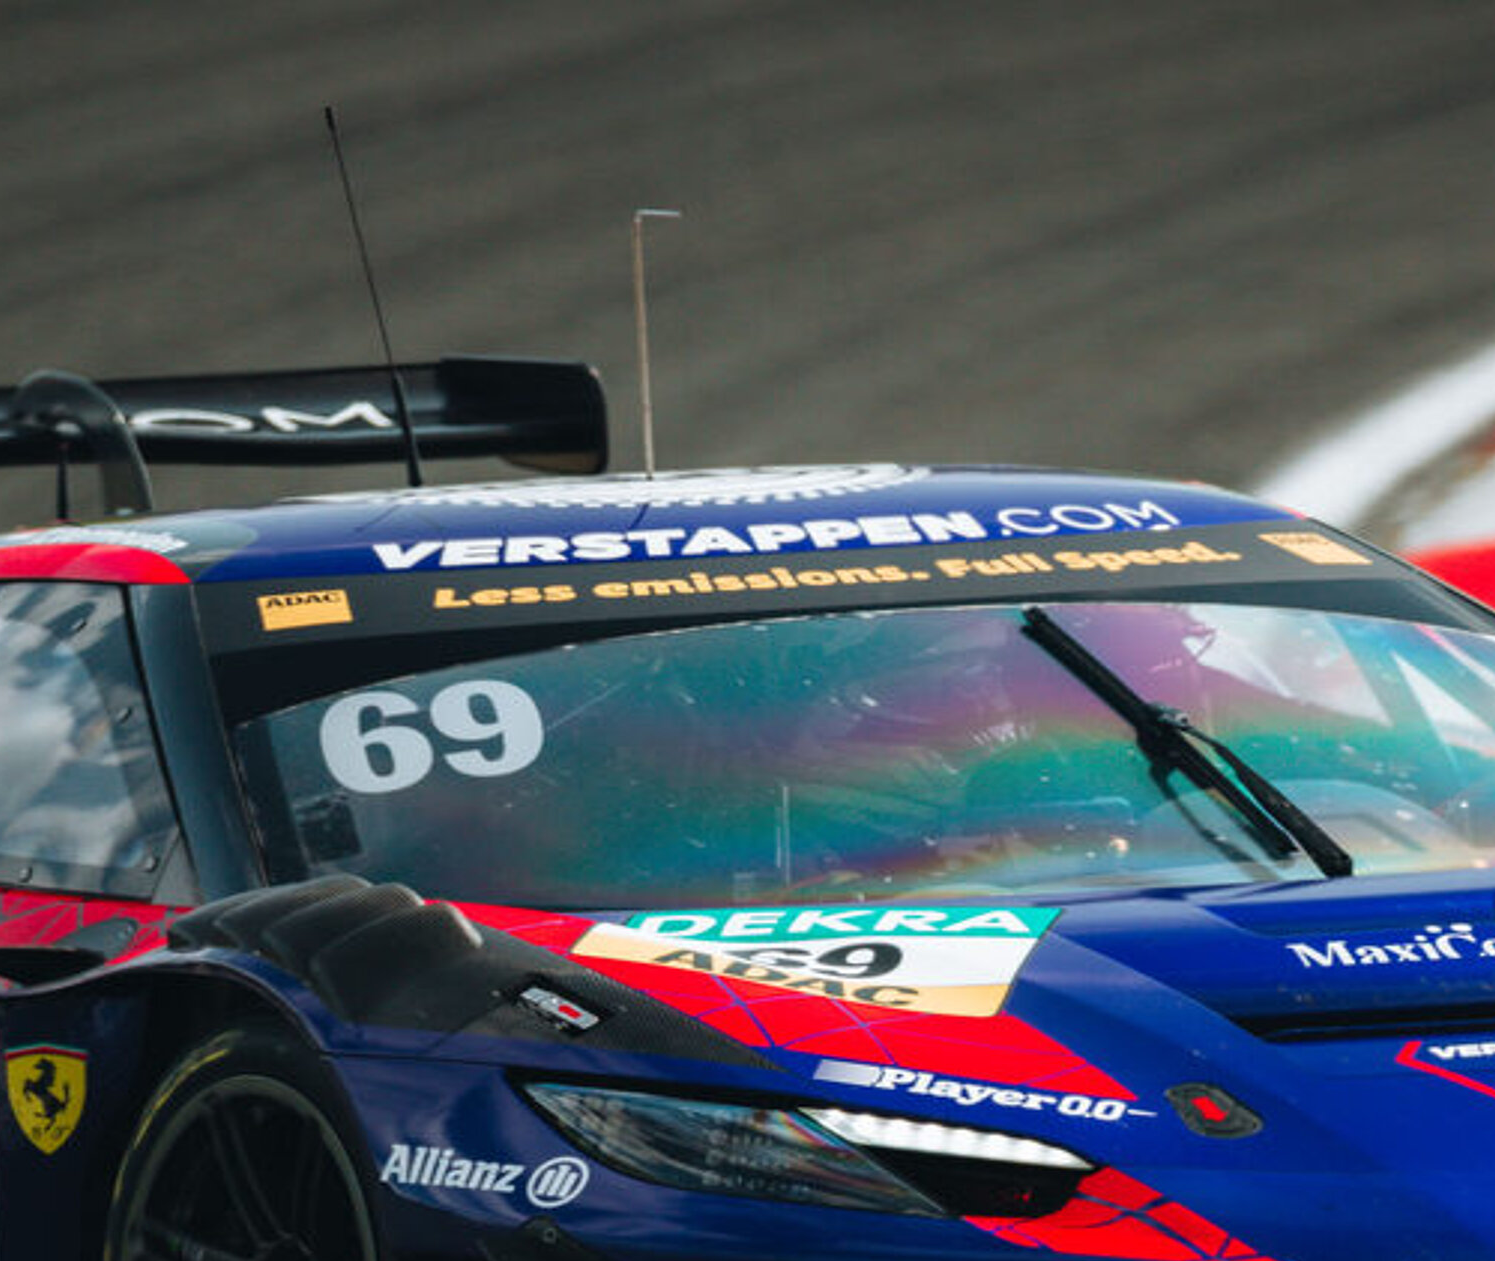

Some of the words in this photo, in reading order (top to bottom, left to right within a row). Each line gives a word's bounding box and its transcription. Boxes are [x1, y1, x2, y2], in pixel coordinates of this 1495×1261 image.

[372, 500, 1181, 569] VERSTAPPEN.COM
[265, 591, 343, 608] ADAC
[433, 583, 577, 609] Less
[593, 564, 930, 599] emissions.
[935, 553, 1053, 579] Full
[1054, 541, 1242, 573] Speed.
[319, 680, 544, 793] 69
[632, 909, 1031, 939] DEKRA
[652, 949, 919, 1007] ADAC
[380, 1143, 525, 1194] Allianz
